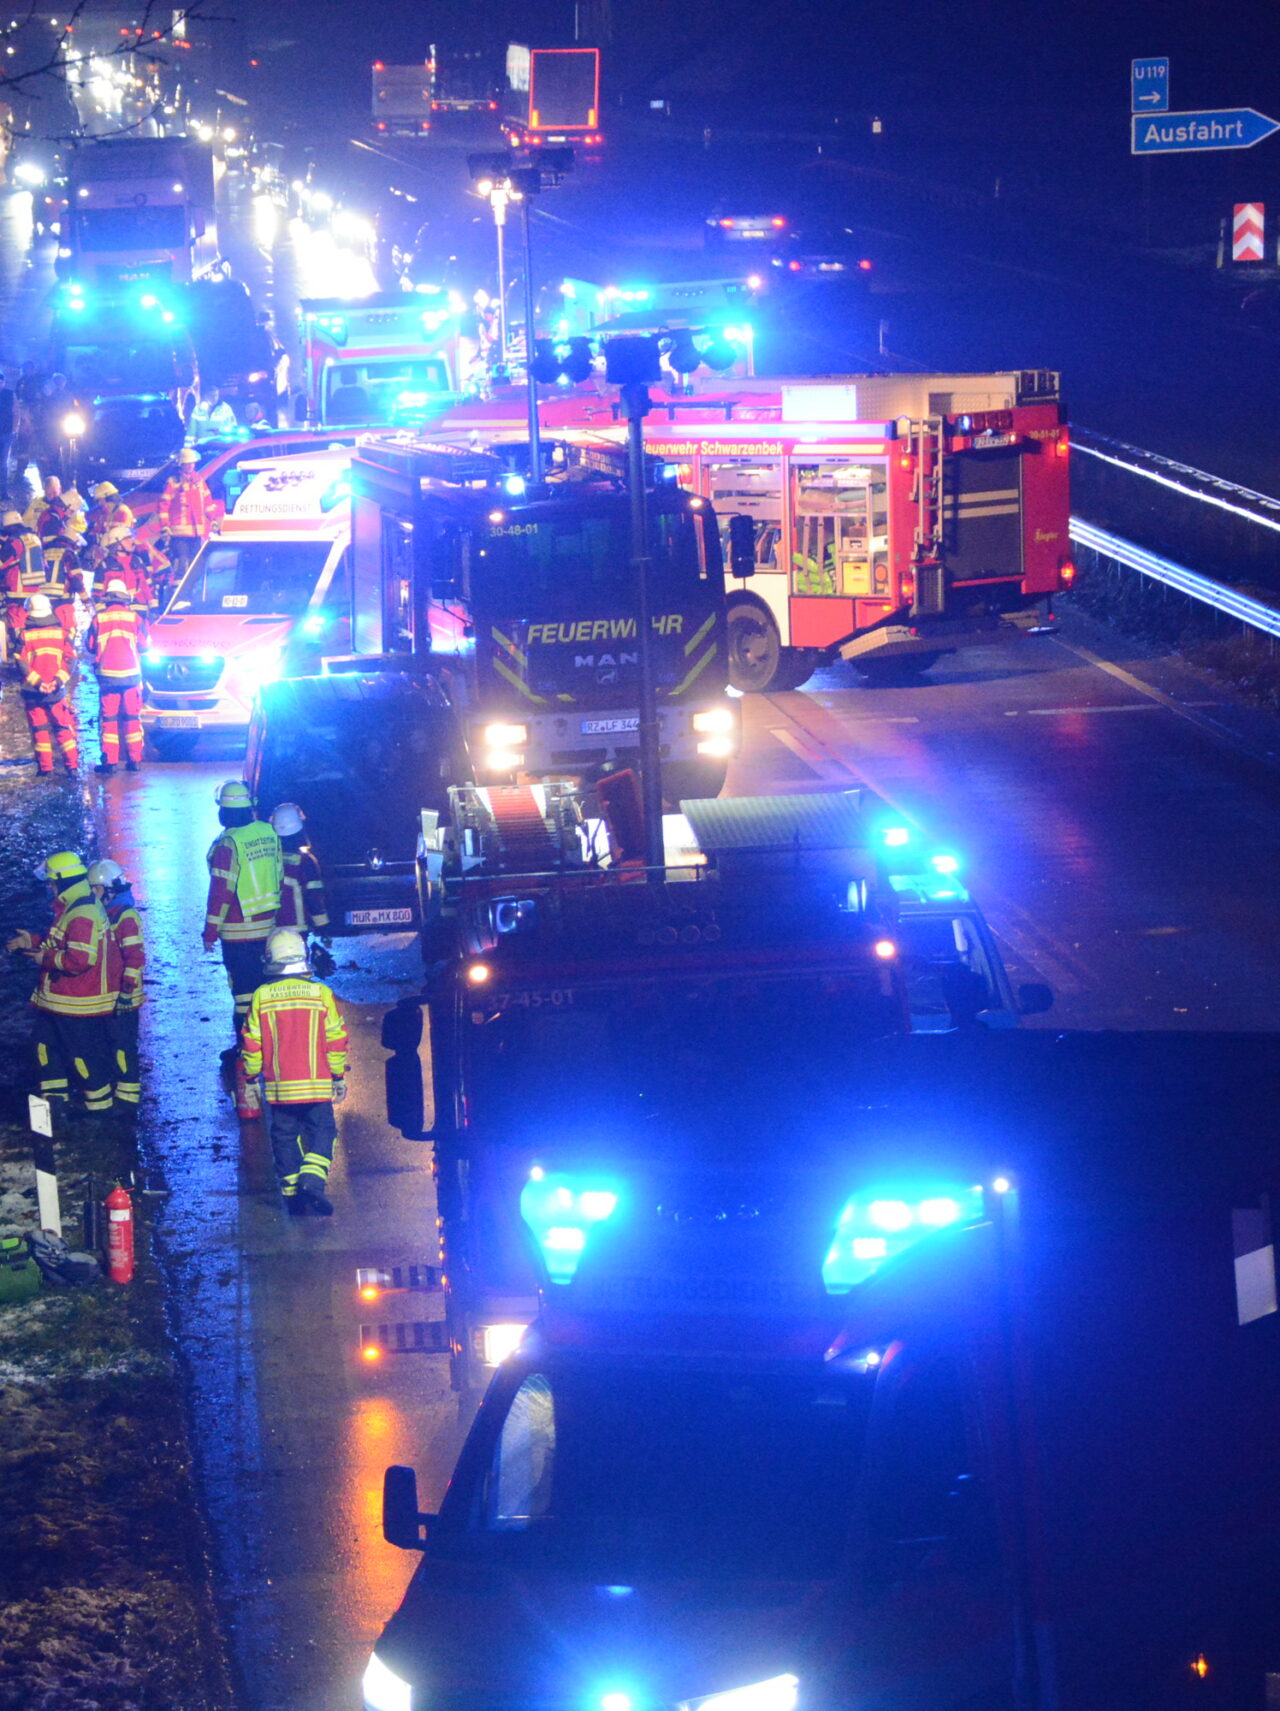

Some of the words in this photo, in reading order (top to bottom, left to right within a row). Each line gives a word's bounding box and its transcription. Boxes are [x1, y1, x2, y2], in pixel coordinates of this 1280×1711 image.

[1144, 120, 1243, 143] Ausfahrt
[701, 442, 784, 455] Schwarzenbek
[240, 503, 312, 514] RETTUNGSDIENST
[490, 523, 539, 538] 30-48-01
[574, 652, 637, 668] MAN
